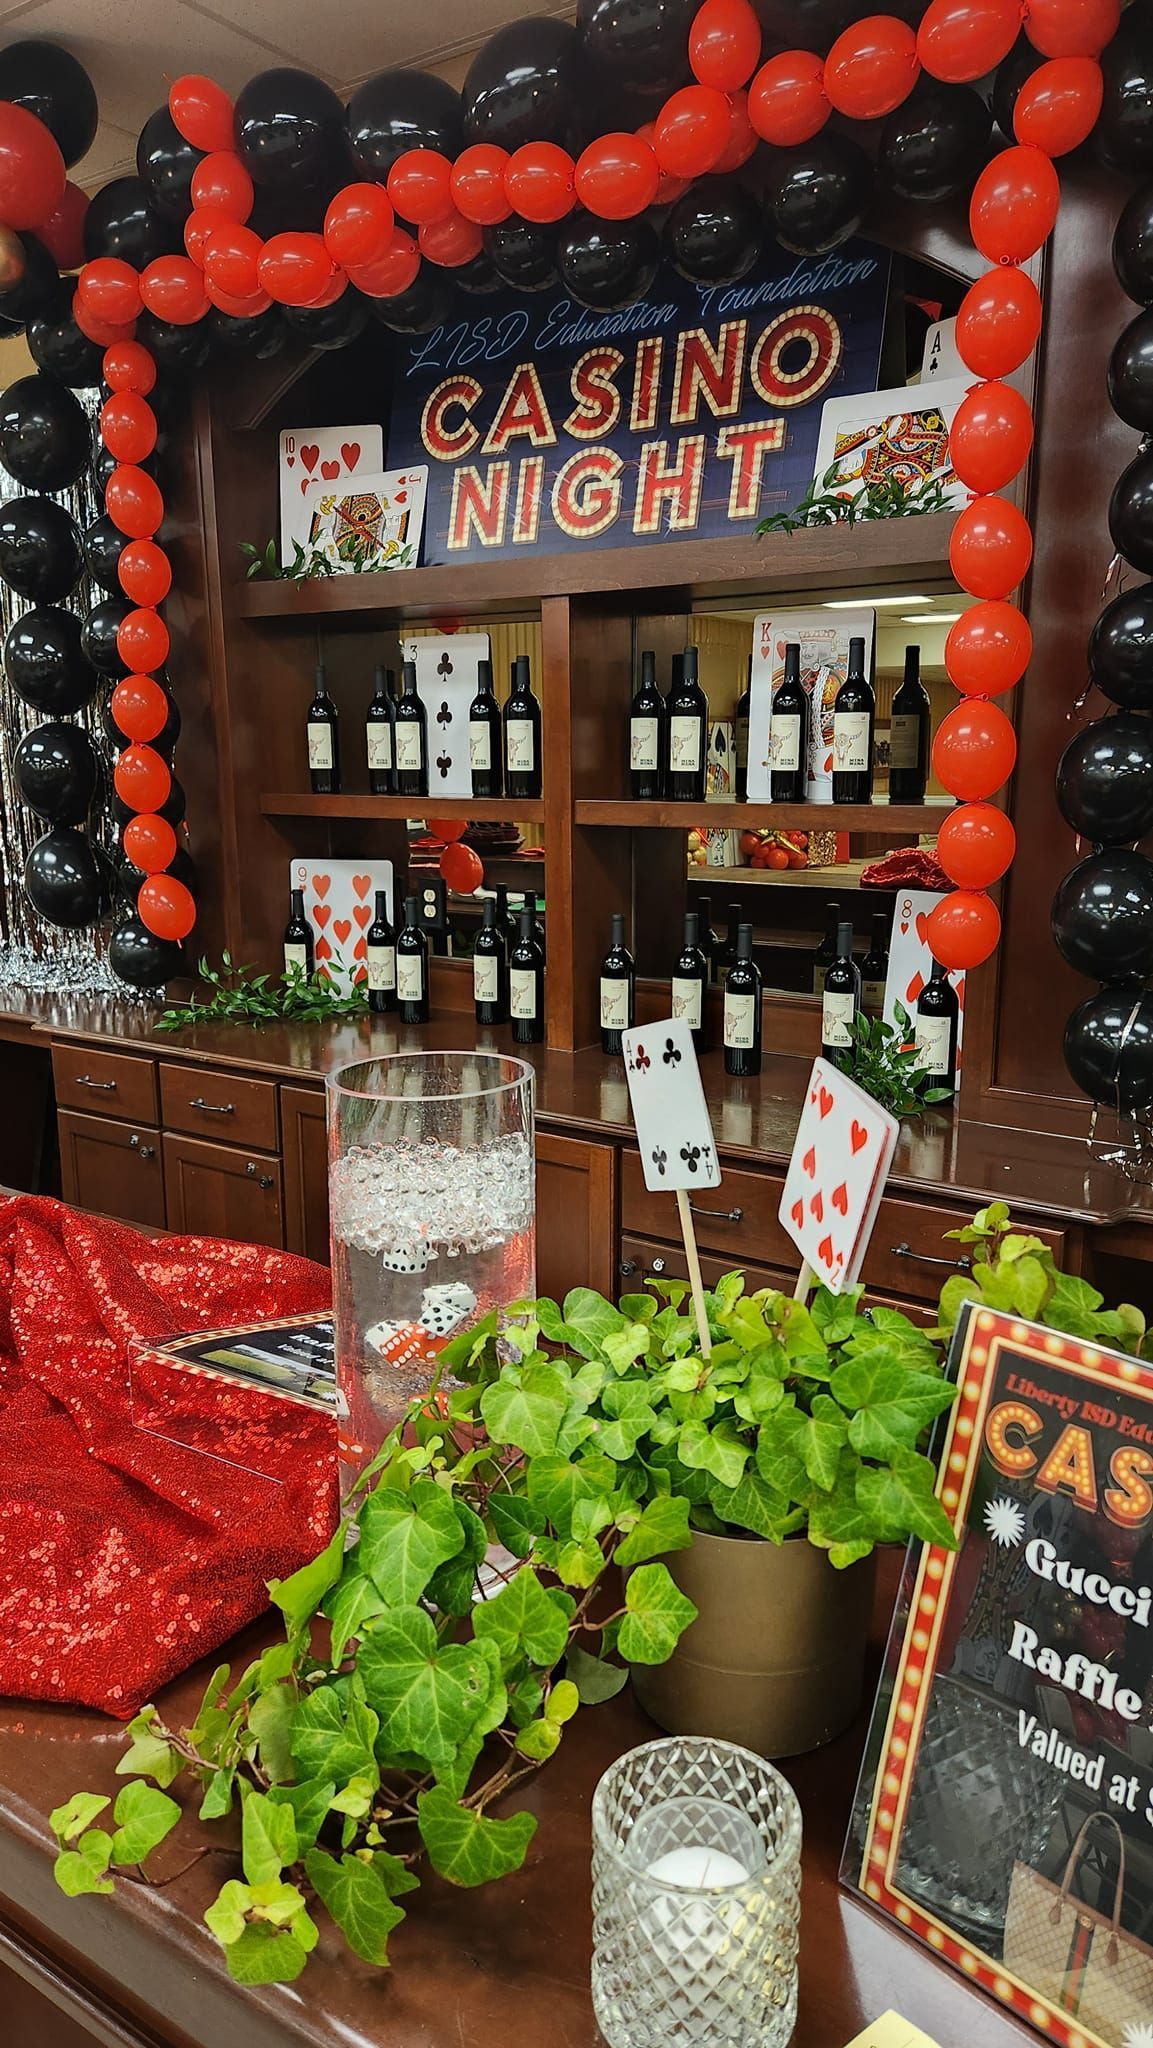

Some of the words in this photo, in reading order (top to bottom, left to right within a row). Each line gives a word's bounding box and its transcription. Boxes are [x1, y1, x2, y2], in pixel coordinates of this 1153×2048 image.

[406, 310, 529, 376] LISD
[533, 299, 679, 350] Education
[930, 330, 942, 355] A
[421, 304, 844, 463] CASINO
[285, 436, 296, 454] 10
[446, 417, 788, 552] NIGHT
[410, 644, 418, 661] 3
[760, 622, 772, 642] K
[298, 866, 307, 882] 9
[902, 899, 912, 918] 8
[1005, 1373, 1081, 1420] Liberty
[1080, 1401, 1117, 1428] ISD
[984, 1400, 1153, 1529] CAS
[1025, 1538, 1152, 1628] Gucci
[1008, 1620, 1143, 1721] Raffle
[1018, 1709, 1106, 1792] Valued
[1109, 1774, 1142, 1813] at
